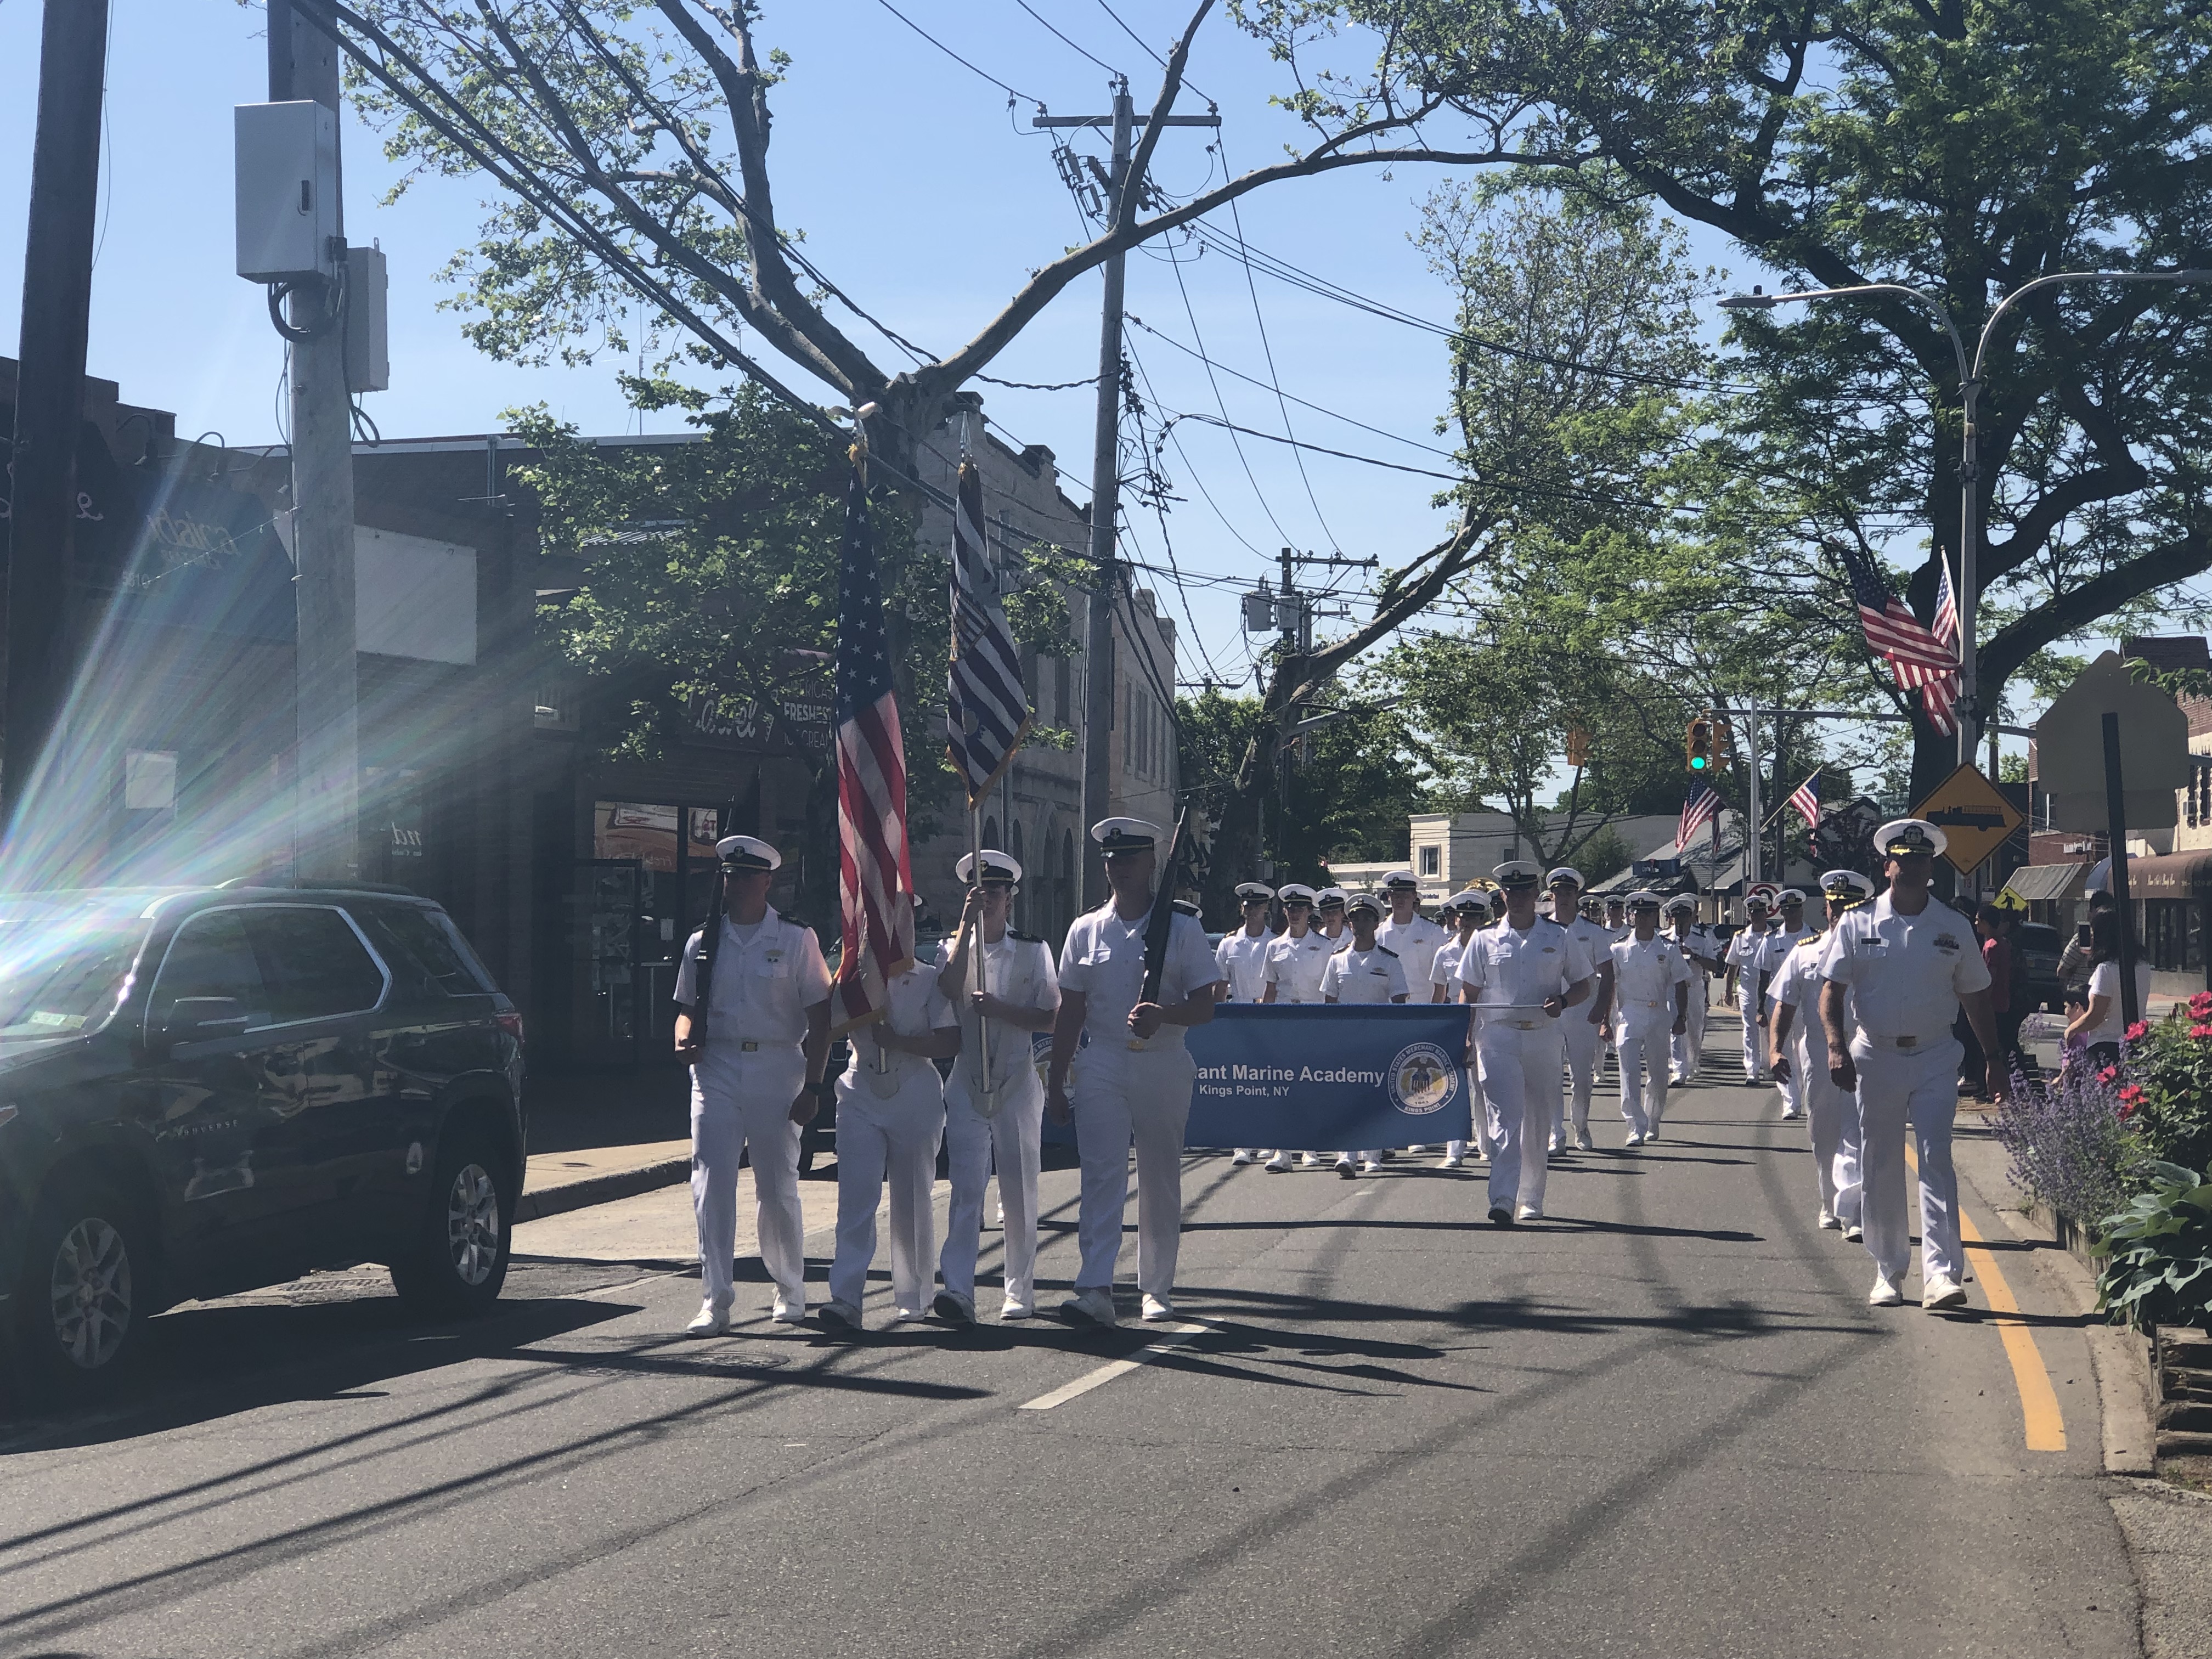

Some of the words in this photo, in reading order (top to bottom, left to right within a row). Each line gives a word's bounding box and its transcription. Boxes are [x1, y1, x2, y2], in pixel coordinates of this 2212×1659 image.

[1392, 1053, 1406, 1071] STATES
[1406, 1045, 1435, 1054] MERCHANT
[1194, 1066, 1227, 1081] ant
[1233, 1065, 1294, 1081] Marine
[1299, 1066, 1385, 1087] Academy
[1199, 1085, 1233, 1097] Kings
[1237, 1085, 1269, 1097] Point,
[1273, 1086, 1289, 1096] NY
[1424, 1102, 1441, 1111] POINT
